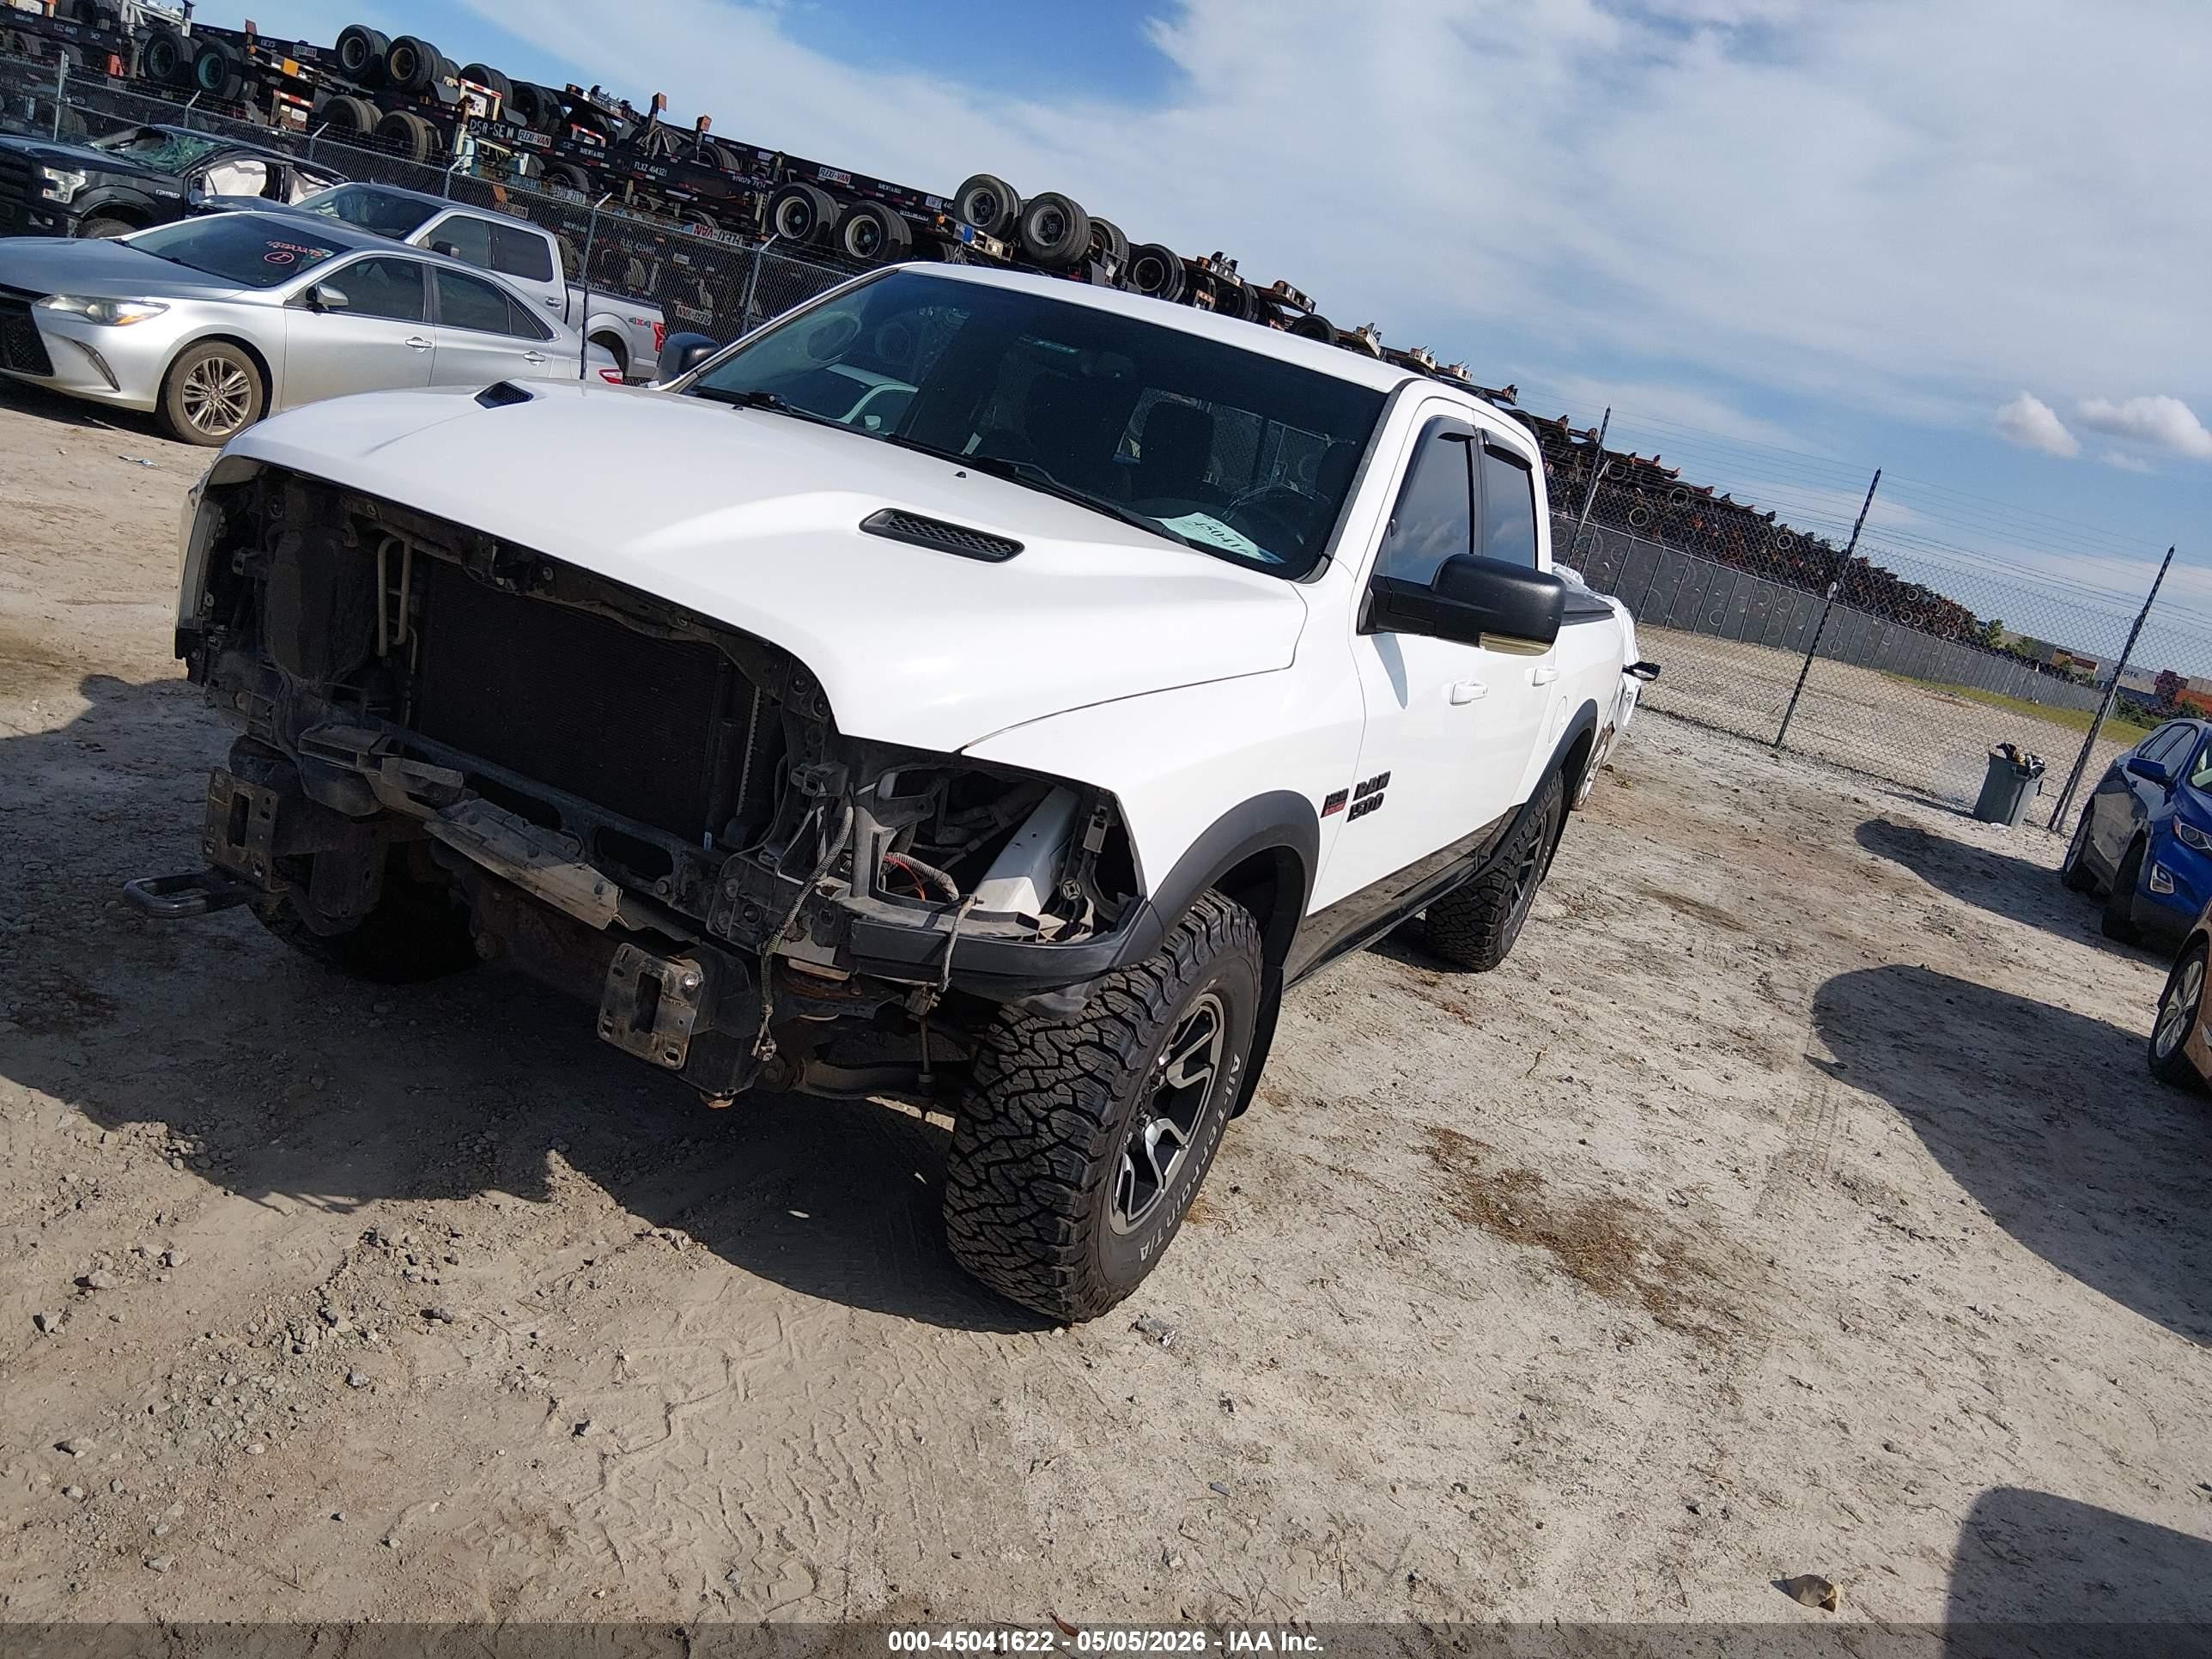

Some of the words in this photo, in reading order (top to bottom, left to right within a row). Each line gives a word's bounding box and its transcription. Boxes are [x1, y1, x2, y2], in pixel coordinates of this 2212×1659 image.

[518, 130, 551, 148] FLEXI-VAN
[635, 161, 647, 172] FLXZ
[819, 167, 851, 184] FLEXI-VAN
[693, 222, 744, 246] FLEXI-VAN
[1352, 770, 1391, 802] RAM
[1346, 792, 1384, 823] 1500
[1140, 1227, 1164, 1262] T/A
